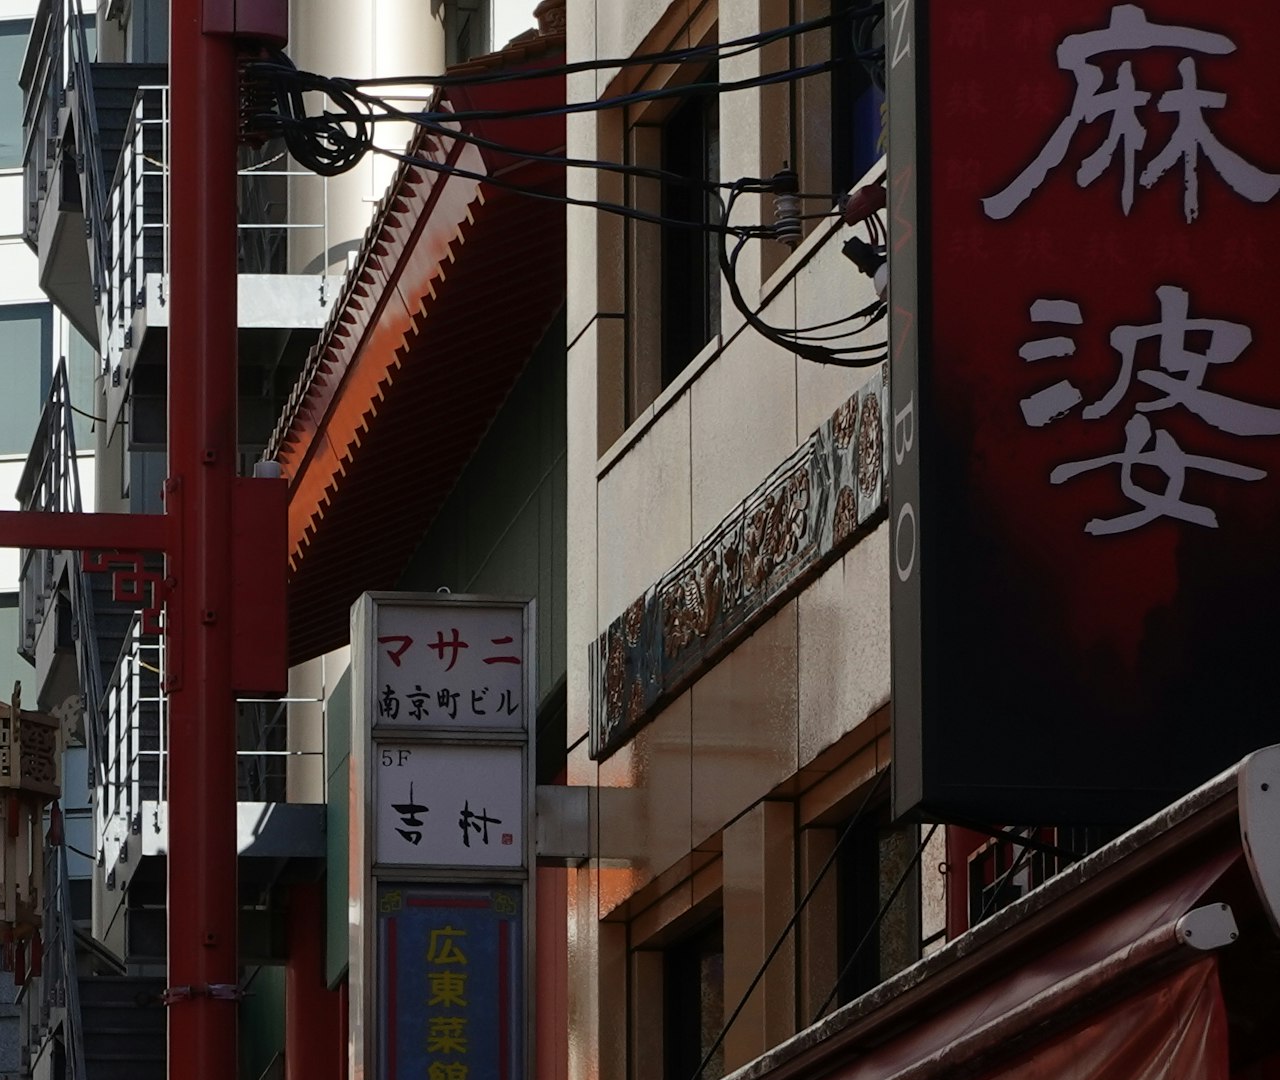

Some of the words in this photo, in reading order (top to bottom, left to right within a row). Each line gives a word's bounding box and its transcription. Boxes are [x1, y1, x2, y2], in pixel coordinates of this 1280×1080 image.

[981, 4, 1280, 535] 麻婆
[377, 628, 522, 672] マサニ
[377, 684, 520, 721] 南京町ビル
[381, 750, 413, 767] 5F
[391, 781, 502, 848] 吉村
